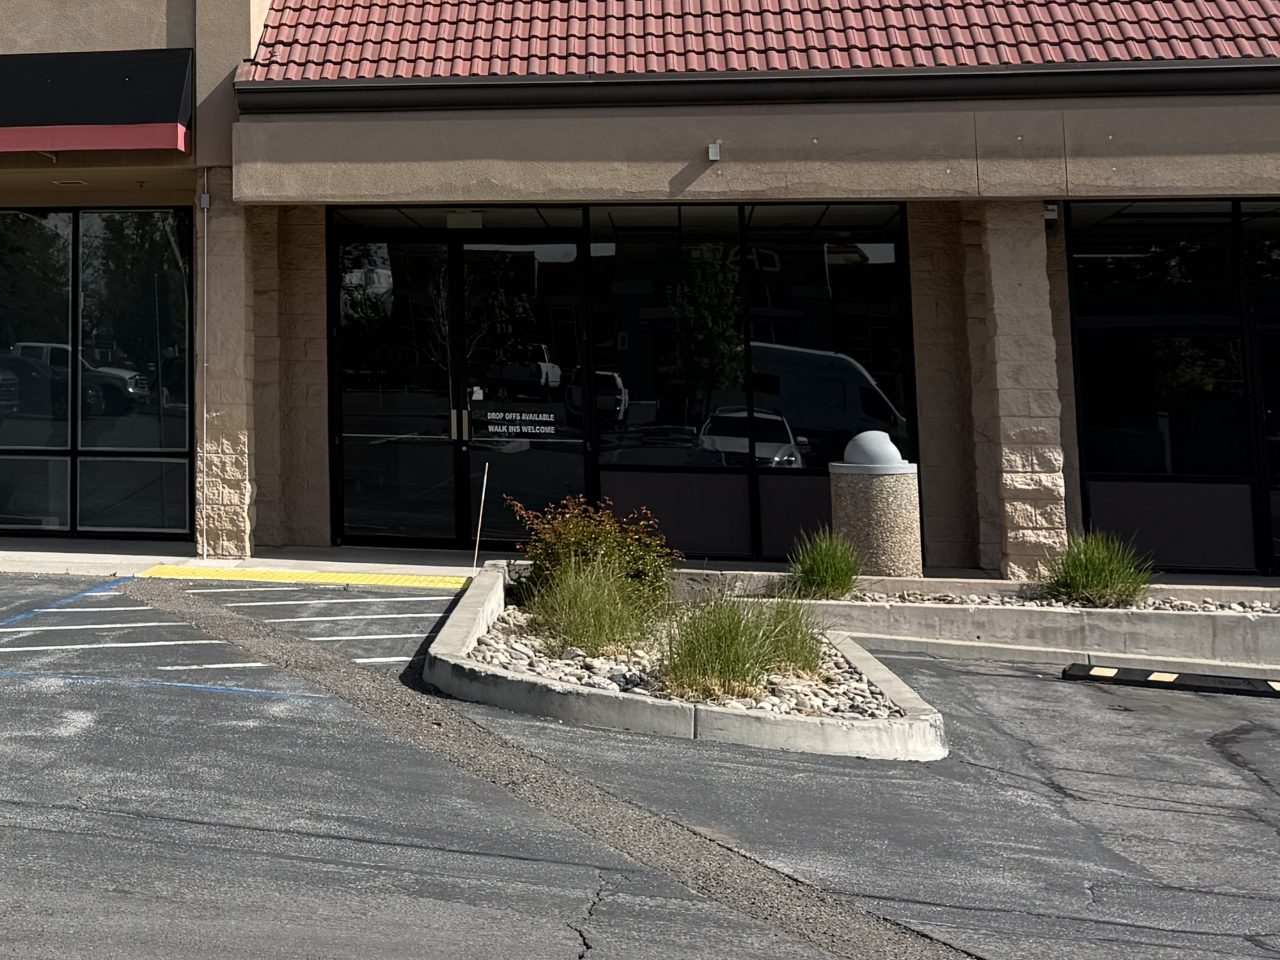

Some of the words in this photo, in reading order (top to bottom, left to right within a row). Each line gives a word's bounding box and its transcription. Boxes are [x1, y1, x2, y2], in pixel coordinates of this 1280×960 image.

[487, 412, 504, 420] DROP
[505, 412, 520, 420] OFFS
[521, 413, 555, 421] AVAILABLE
[488, 425, 507, 433] WALK
[508, 425, 520, 433] INS
[521, 425, 556, 434] WELCOME
